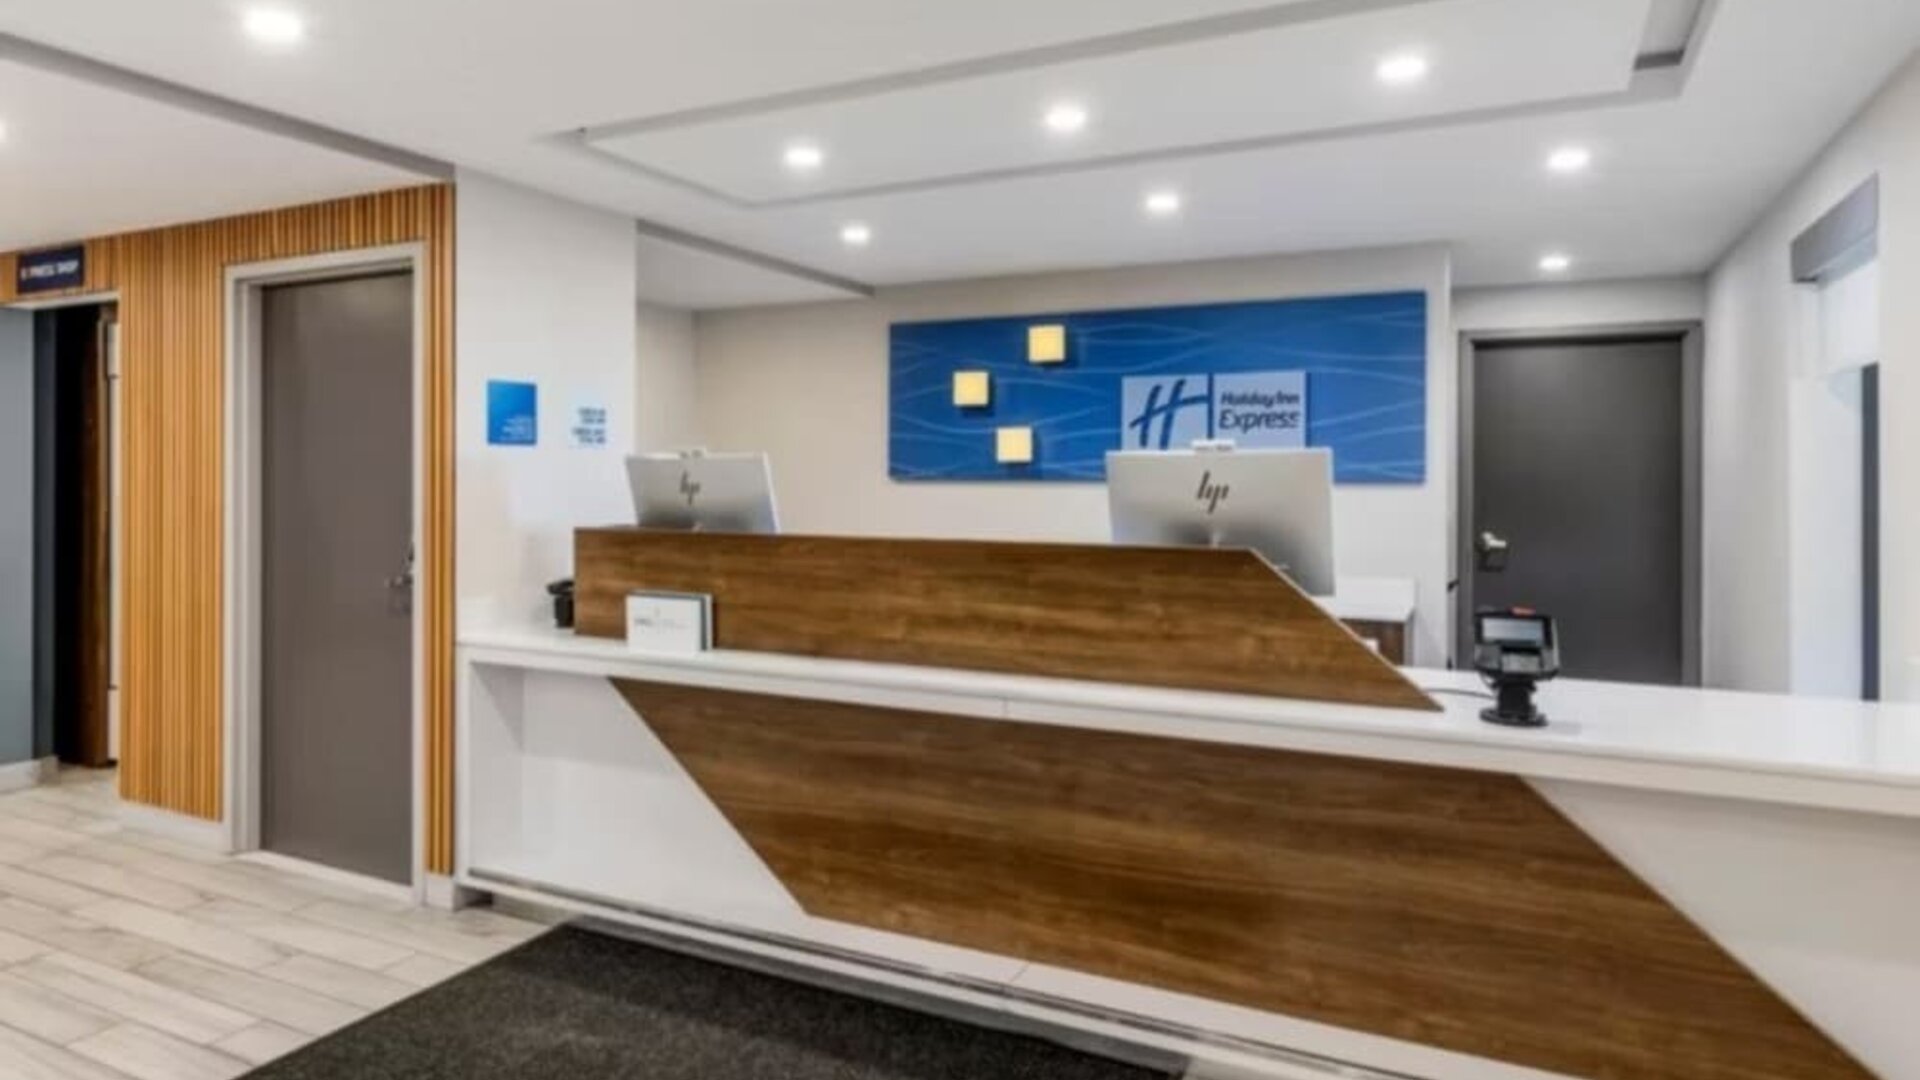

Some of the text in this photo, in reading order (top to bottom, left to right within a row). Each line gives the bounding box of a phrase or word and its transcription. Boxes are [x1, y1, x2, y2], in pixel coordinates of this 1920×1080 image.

[1221, 390, 1299, 408] Holiday Inn
[1219, 409, 1299, 434] Express
[1196, 470, 1229, 514] hp
